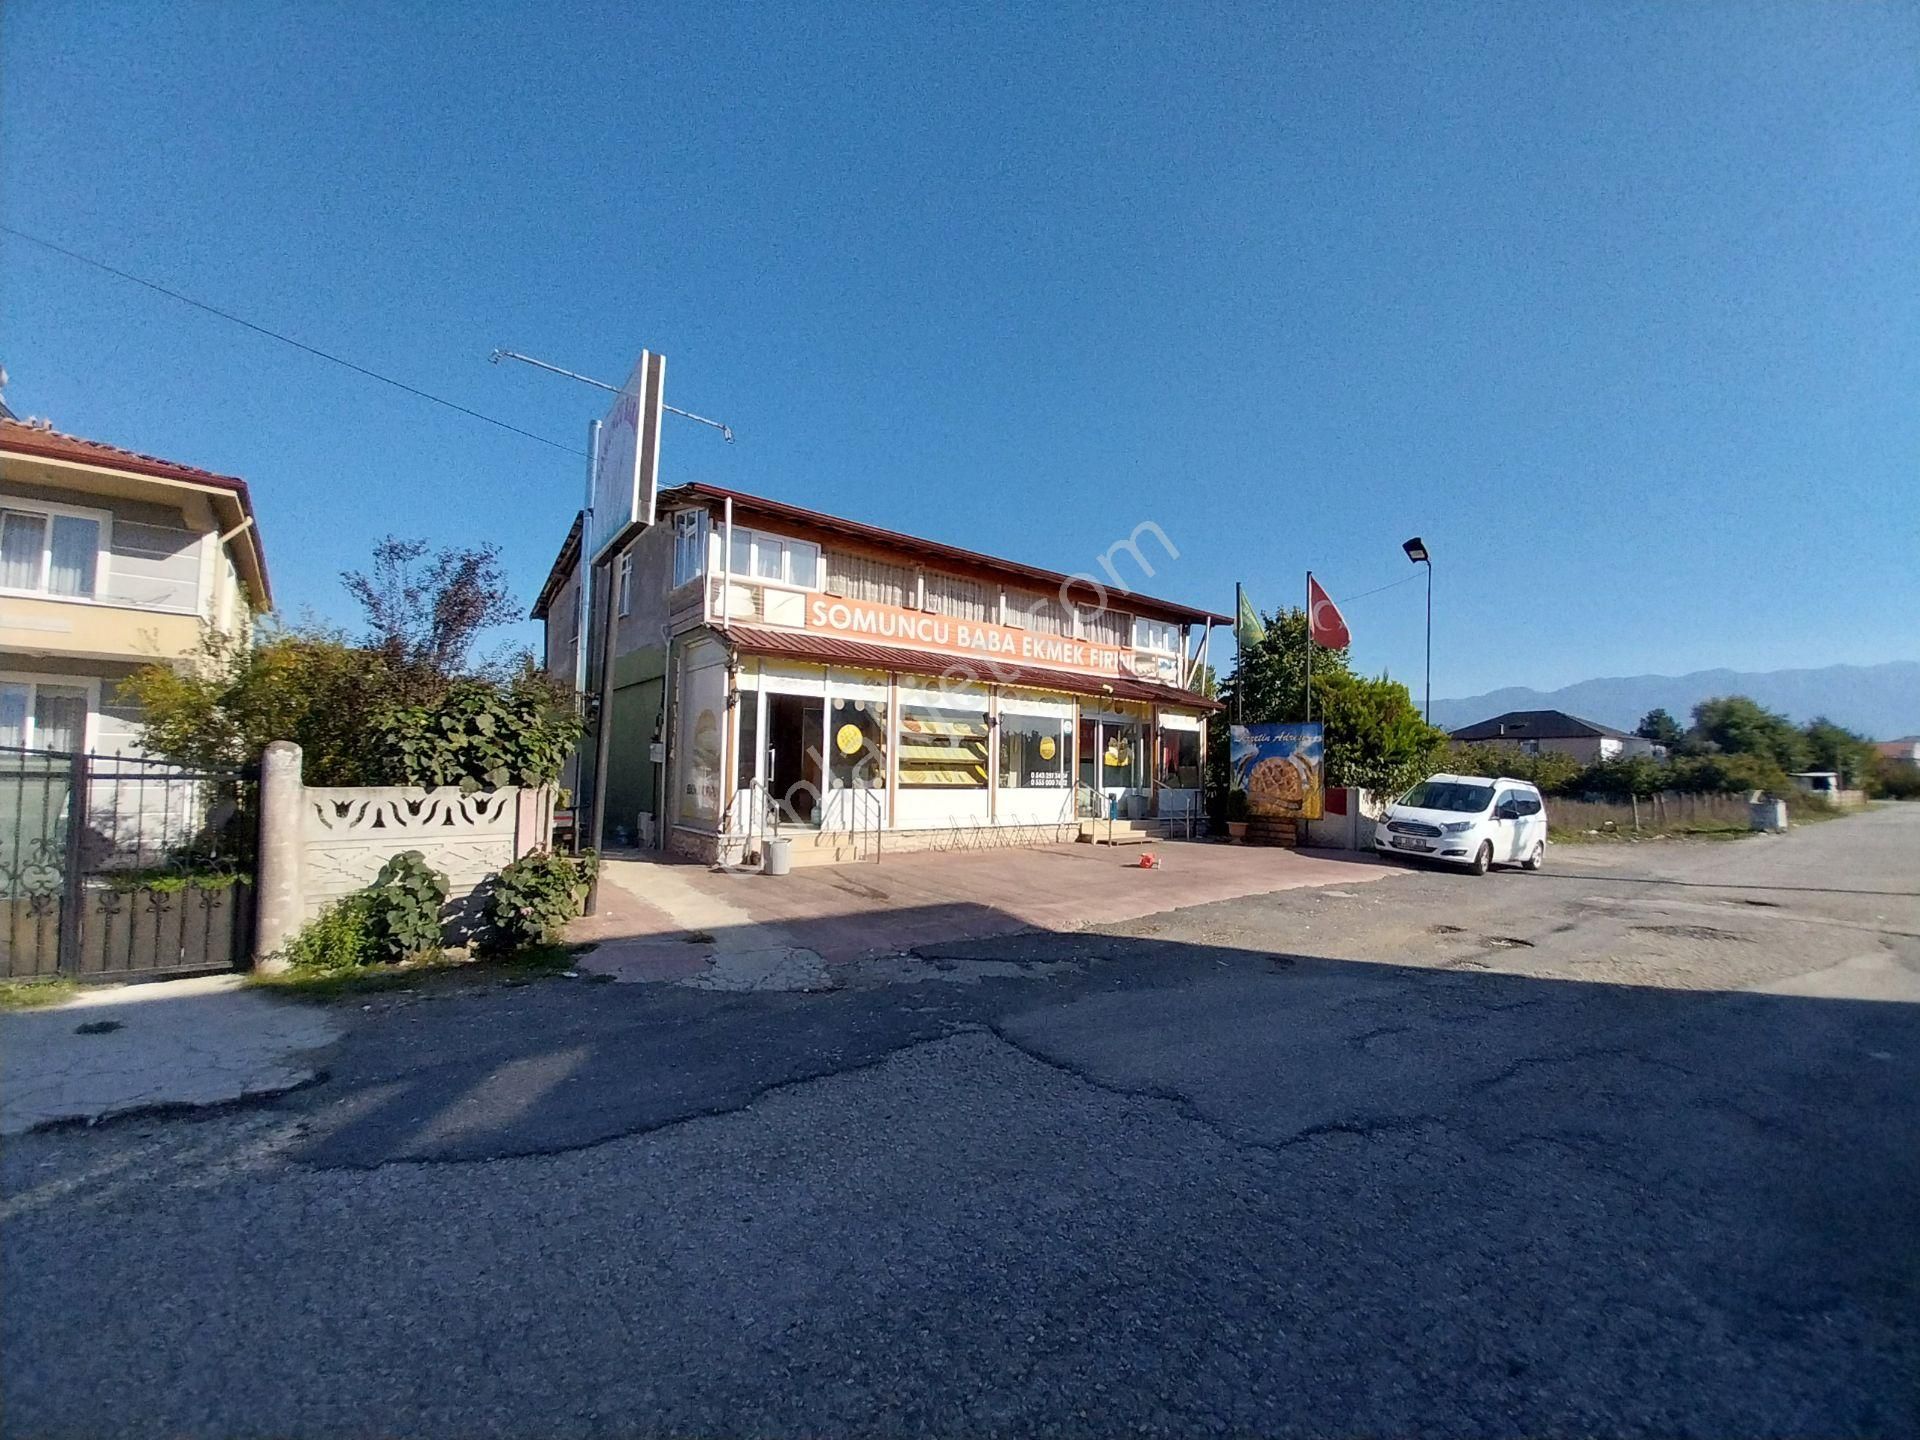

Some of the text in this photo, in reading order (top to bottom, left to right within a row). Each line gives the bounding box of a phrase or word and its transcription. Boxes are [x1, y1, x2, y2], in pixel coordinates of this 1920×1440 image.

[812, 600, 949, 645] SOMUNCU
[957, 625, 1017, 655] BABA
[1022, 636, 1086, 666] EKMEK
